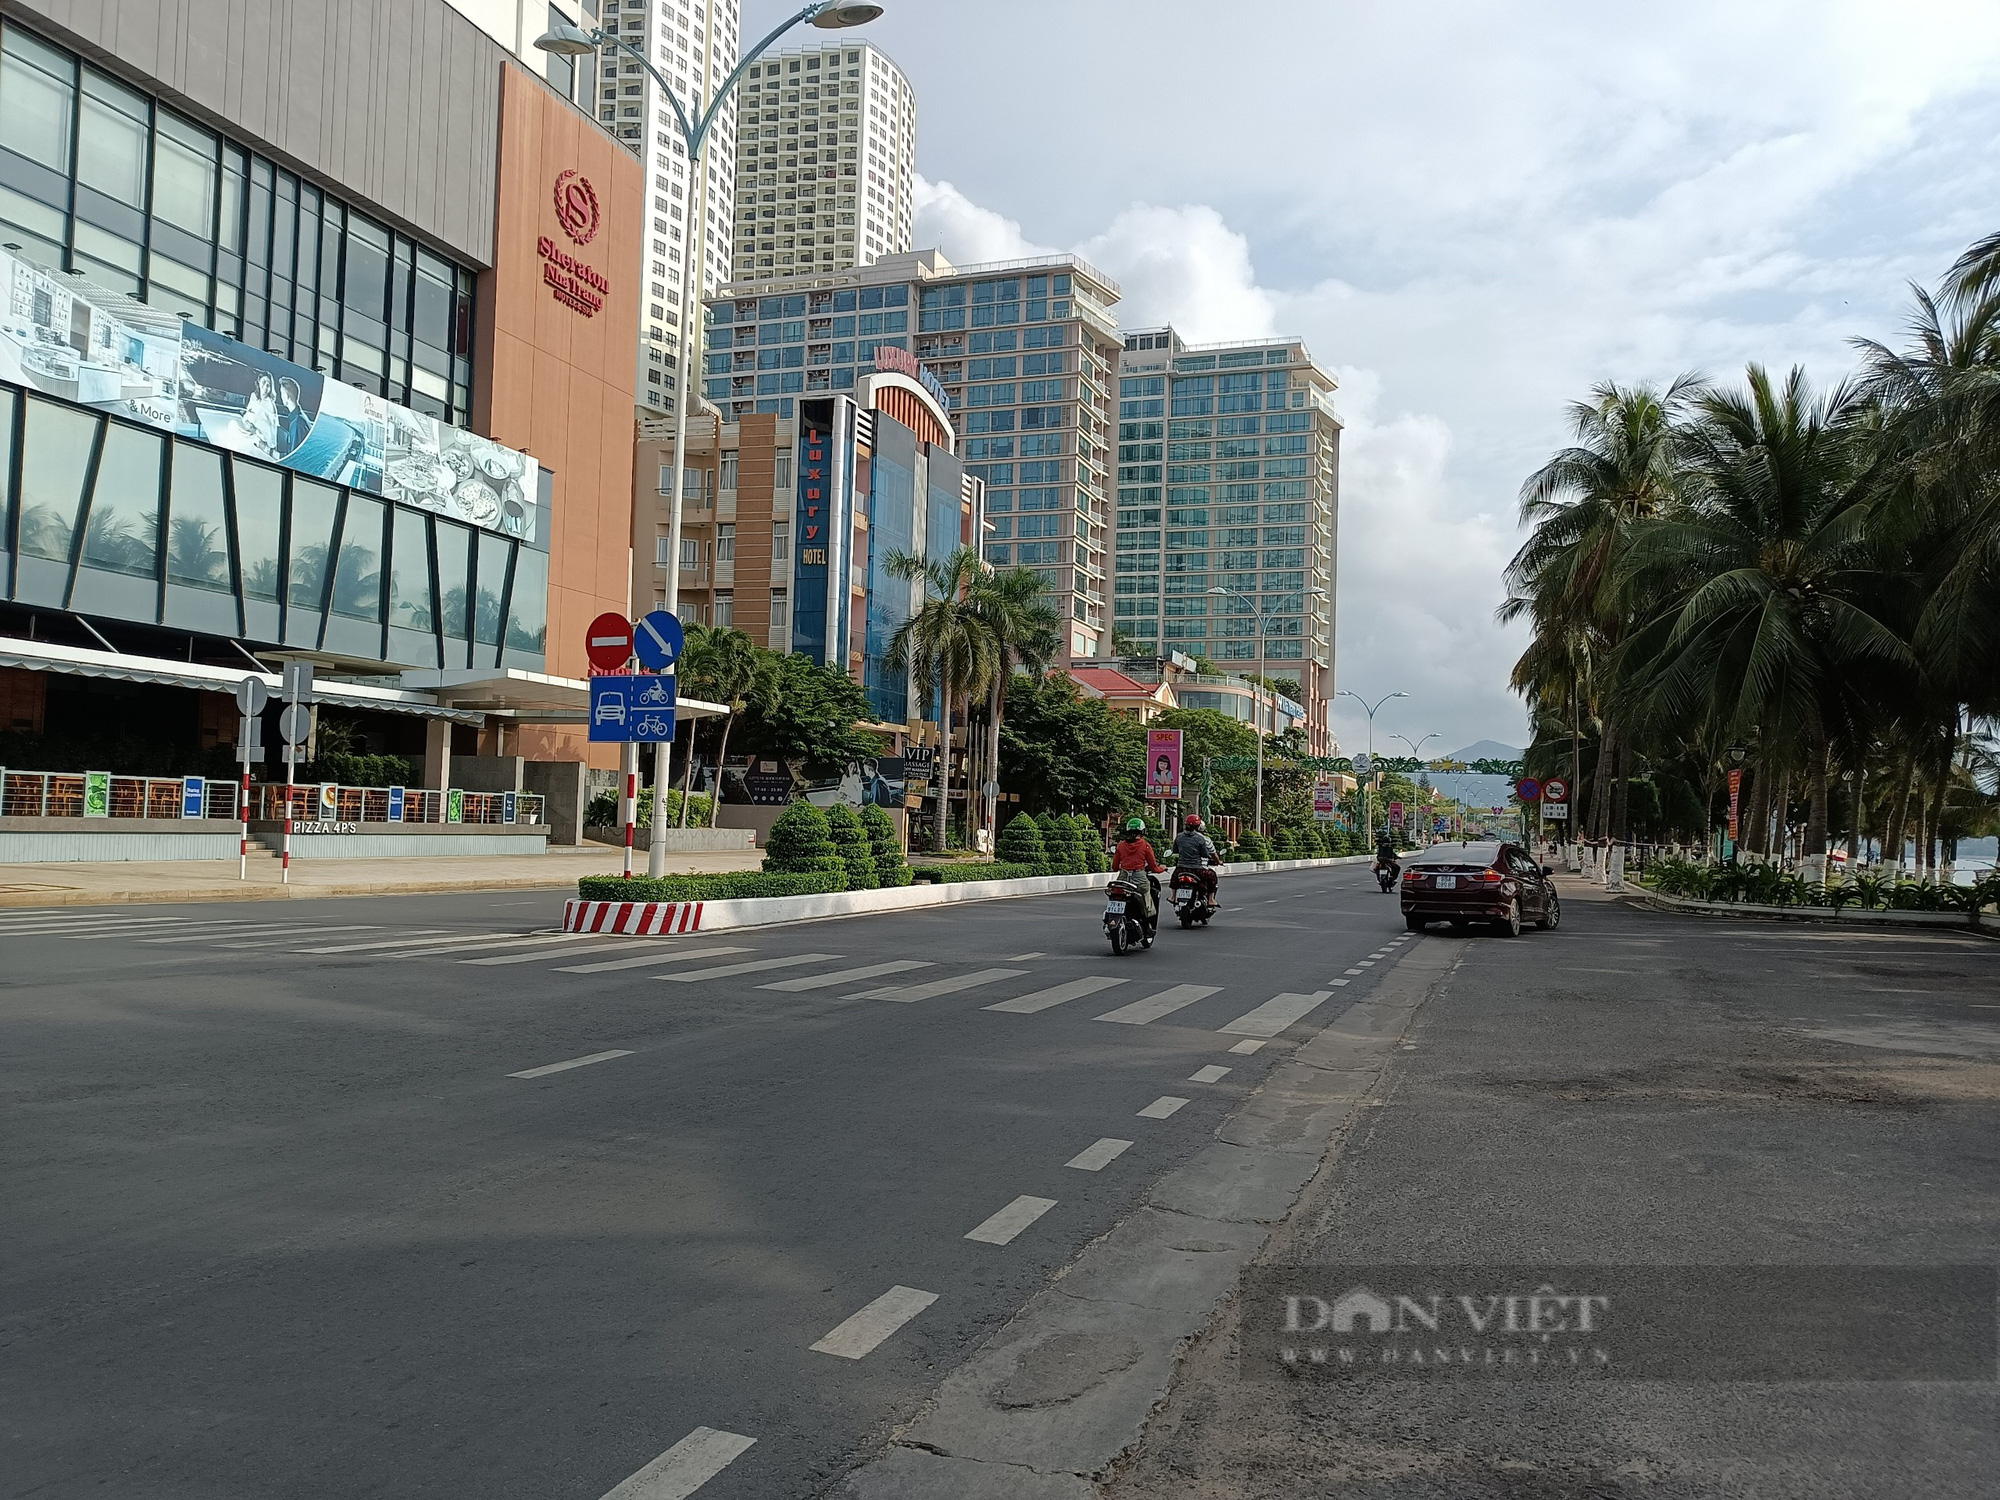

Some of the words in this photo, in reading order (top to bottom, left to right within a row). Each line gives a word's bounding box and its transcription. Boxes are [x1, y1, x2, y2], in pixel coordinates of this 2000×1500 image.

[538, 236, 610, 295] Sheraton
[544, 263, 570, 289] Nha
[569, 277, 604, 313] Trang
[874, 346, 919, 379] LUXURY
[920, 362, 951, 419] HOTEL
[129, 399, 138, 413] &
[140, 403, 171, 423] More
[806, 429, 822, 540] Luxury
[803, 549, 826, 565] HOTEL
[906, 748, 930, 761] VIP
[293, 821, 329, 834] PIZZA
[333, 821, 357, 834] 4P'S
